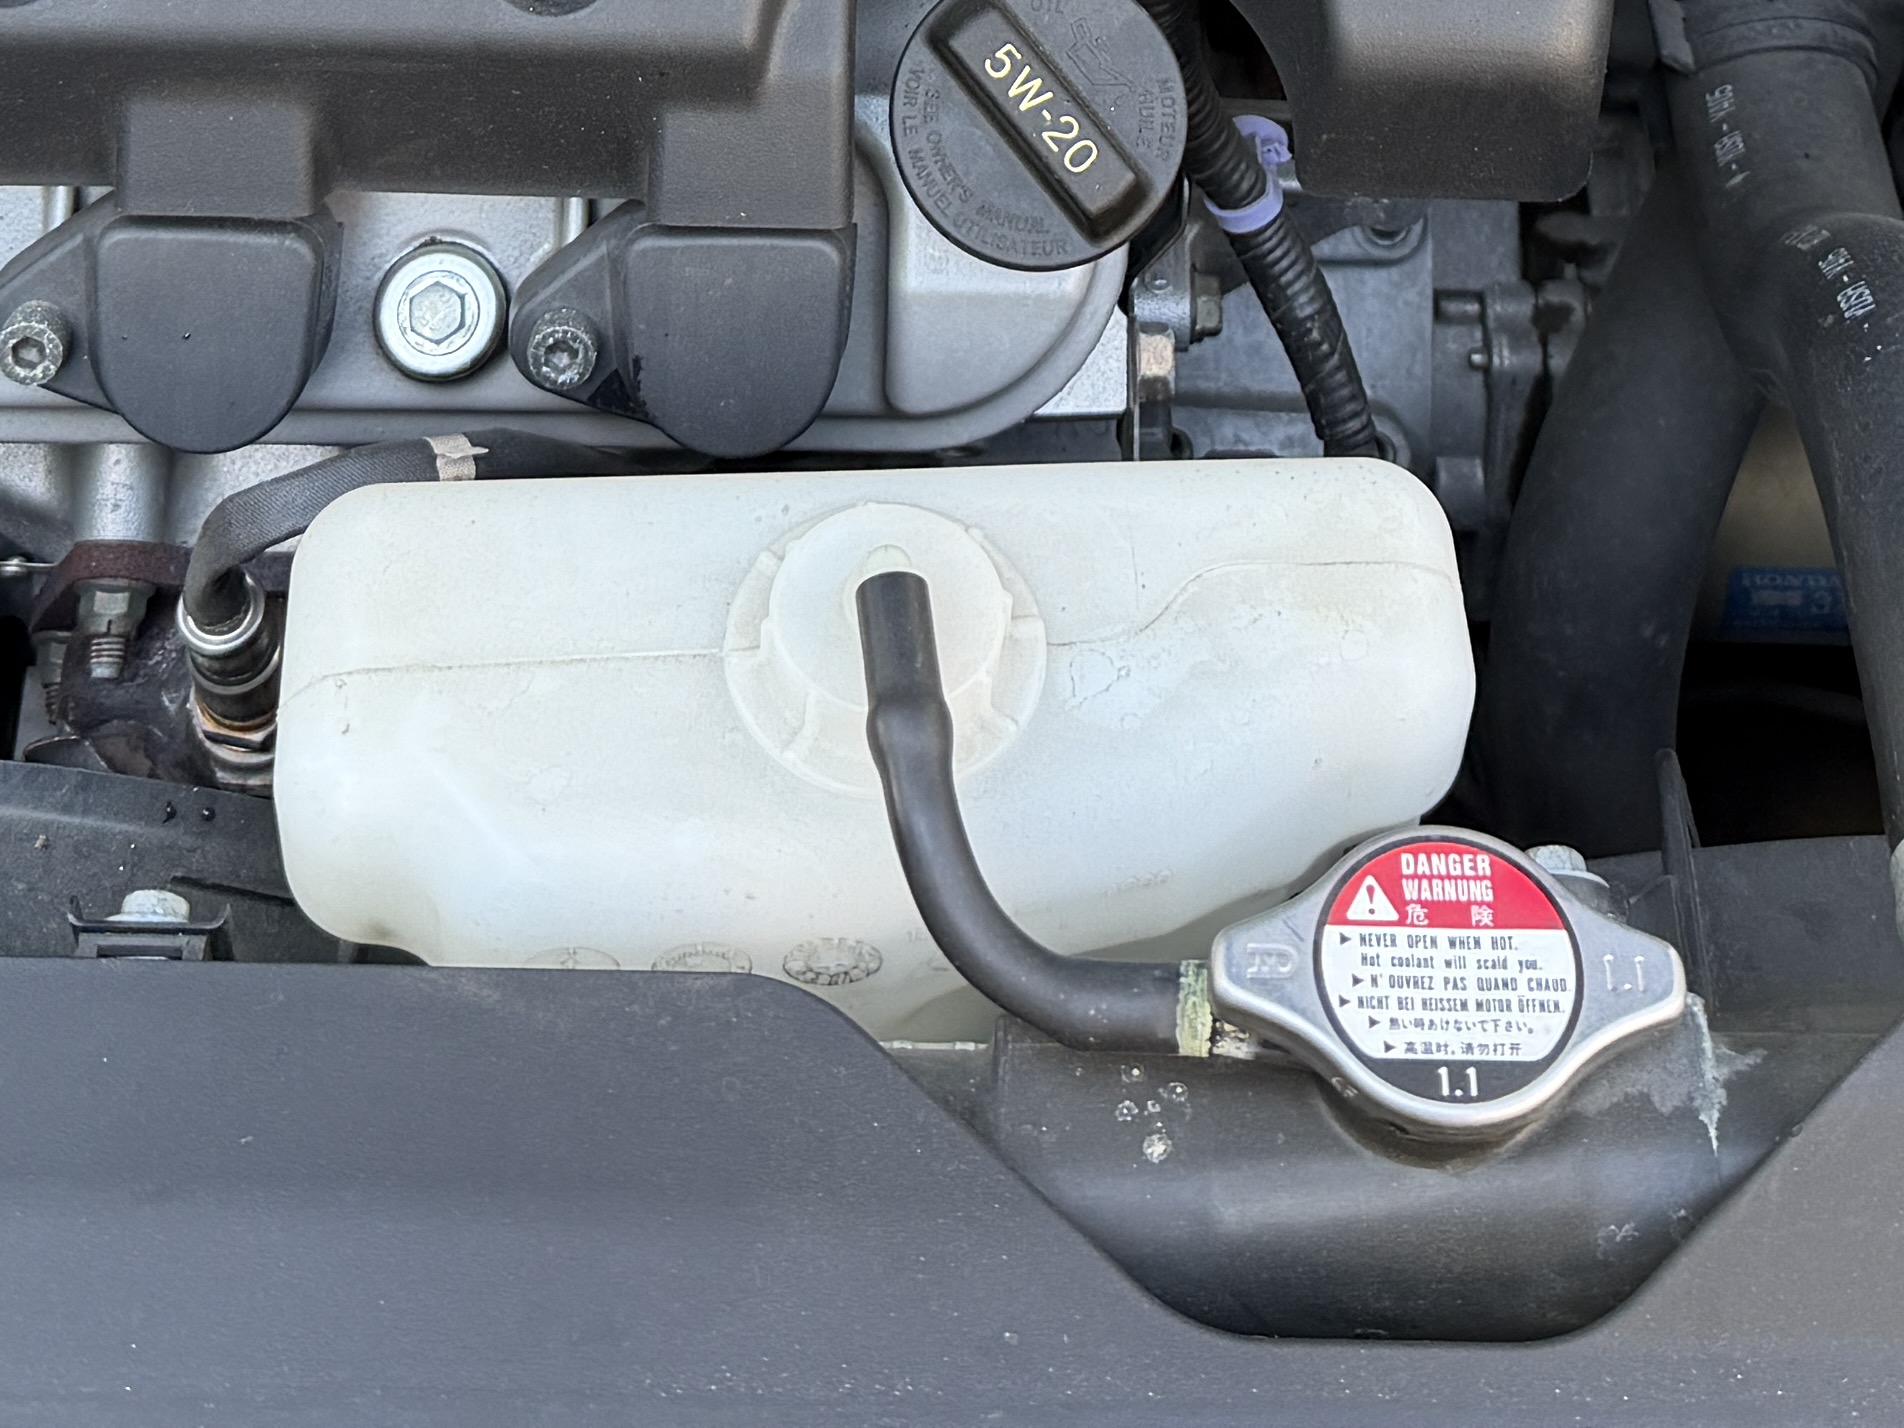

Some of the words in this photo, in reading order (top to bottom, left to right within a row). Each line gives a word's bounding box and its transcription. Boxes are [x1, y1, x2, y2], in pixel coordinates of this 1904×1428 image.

[984, 43, 1098, 173] 5W-20
[1156, 77, 1177, 162] MOTEUR
[1400, 852, 1492, 877] DANGER
[1402, 878, 1494, 902] WARNUNG
[1359, 932, 1396, 948] NEVER
[1407, 933, 1438, 949] OPEN
[1447, 935, 1482, 950] WHEN
[1491, 935, 1518, 951] HOT.
[1361, 952, 1381, 968] Hot
[1390, 953, 1435, 969] coolant
[1444, 954, 1466, 969] will
[1476, 954, 1508, 970] scald
[1517, 958, 1543, 973] you.
[1603, 953, 1645, 992] 1.1
[1388, 975, 1434, 990] OUVREZ
[1443, 976, 1467, 991] PAS
[1477, 976, 1518, 992] QUAND
[1357, 995, 1389, 1010] NICHT
[1397, 996, 1415, 1010] BEI
[1421, 997, 1469, 1012] HEISSEM
[1475, 998, 1512, 1012] MOTOR
[1437, 1066, 1479, 1097] 1.1
